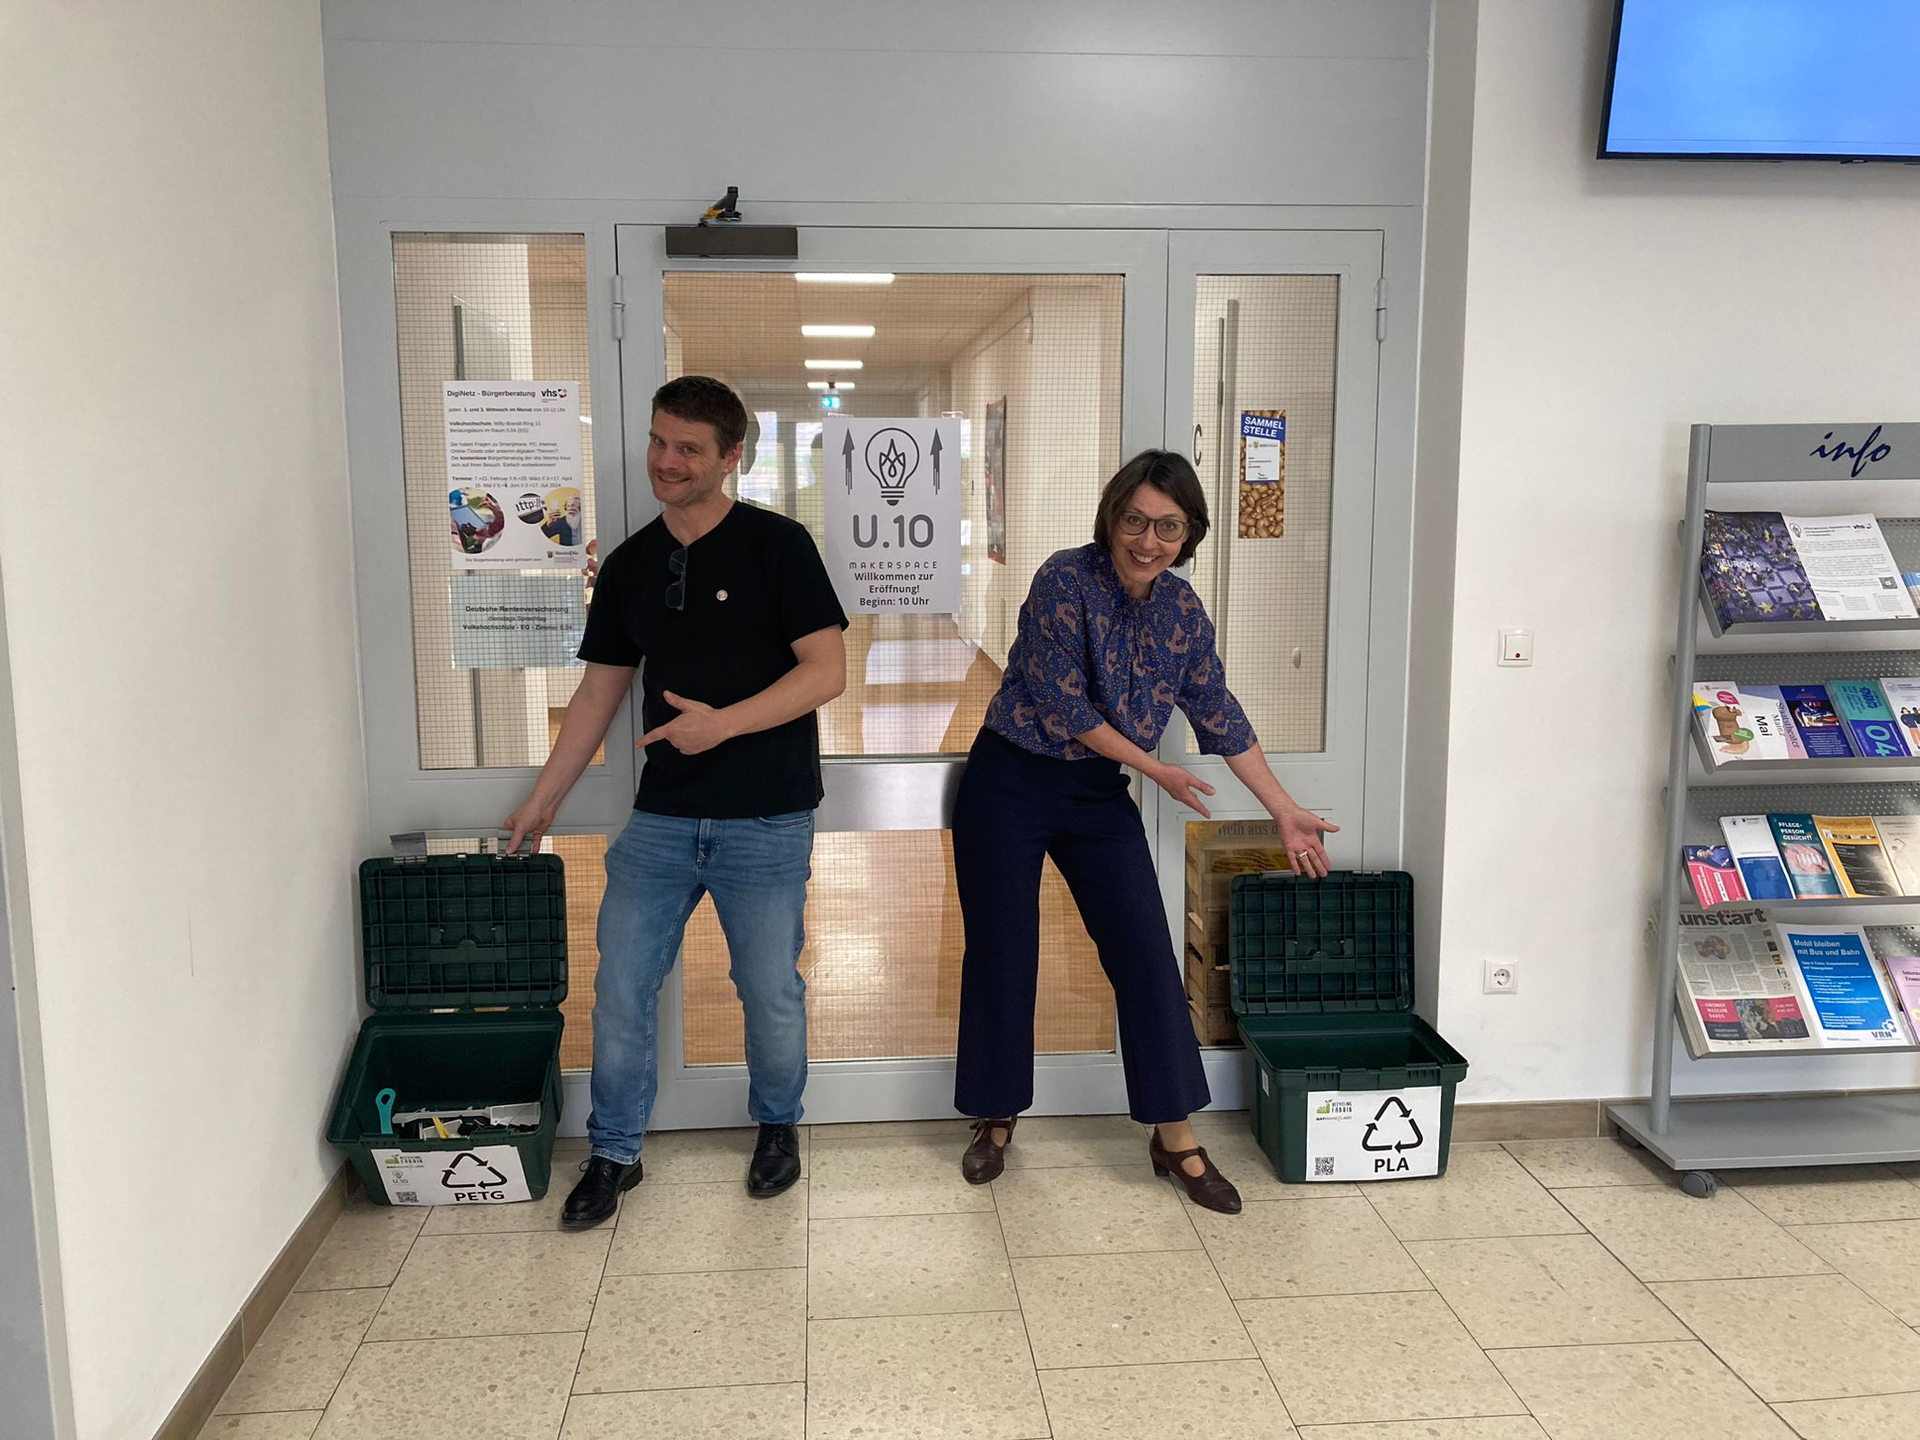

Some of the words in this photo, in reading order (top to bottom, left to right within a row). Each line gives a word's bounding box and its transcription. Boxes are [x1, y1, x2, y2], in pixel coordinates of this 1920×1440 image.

[447, 390, 476, 398] DigiNetz
[482, 390, 536, 398] Bürgerberatung
[541, 388, 558, 398] vhs
[1245, 416, 1284, 429] SAMMEL
[1243, 426, 1277, 438] STELLE
[1810, 425, 1891, 477] info
[853, 514, 934, 548] U.10
[855, 572, 916, 581] Willkommen
[869, 584, 920, 595] Eröffnung!
[860, 598, 896, 608] Beginn:
[1755, 715, 1772, 736] Mai
[1776, 702, 1799, 749] Staatstheater
[1865, 725, 1898, 756] 04
[1248, 824, 1268, 835] aus
[1679, 908, 1767, 926] unst:art
[1374, 1157, 1409, 1173] PLA
[454, 1190, 505, 1201] PETG
